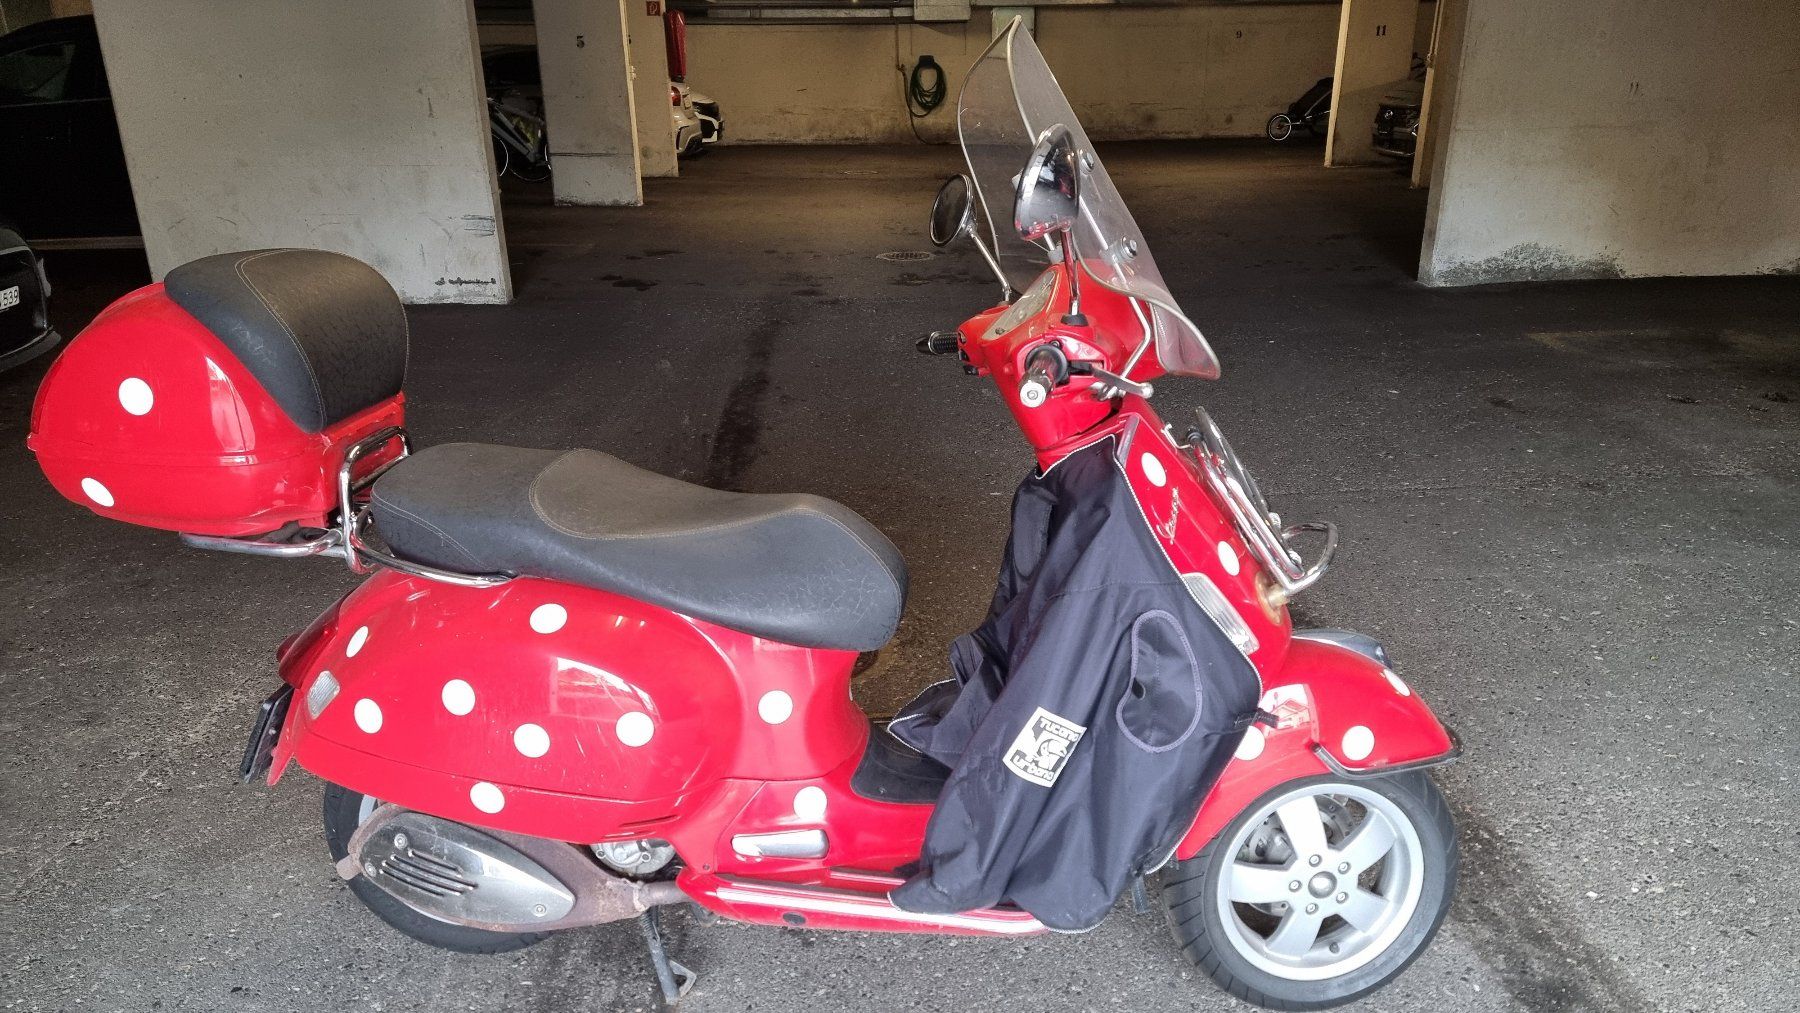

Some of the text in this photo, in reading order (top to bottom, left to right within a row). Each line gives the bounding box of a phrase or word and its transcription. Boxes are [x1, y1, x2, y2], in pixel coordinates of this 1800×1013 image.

[1236, 30, 1242, 39] 9
[1376, 24, 1386, 36] 11
[576, 35, 585, 49] 5
[0, 289, 18, 307] 539
